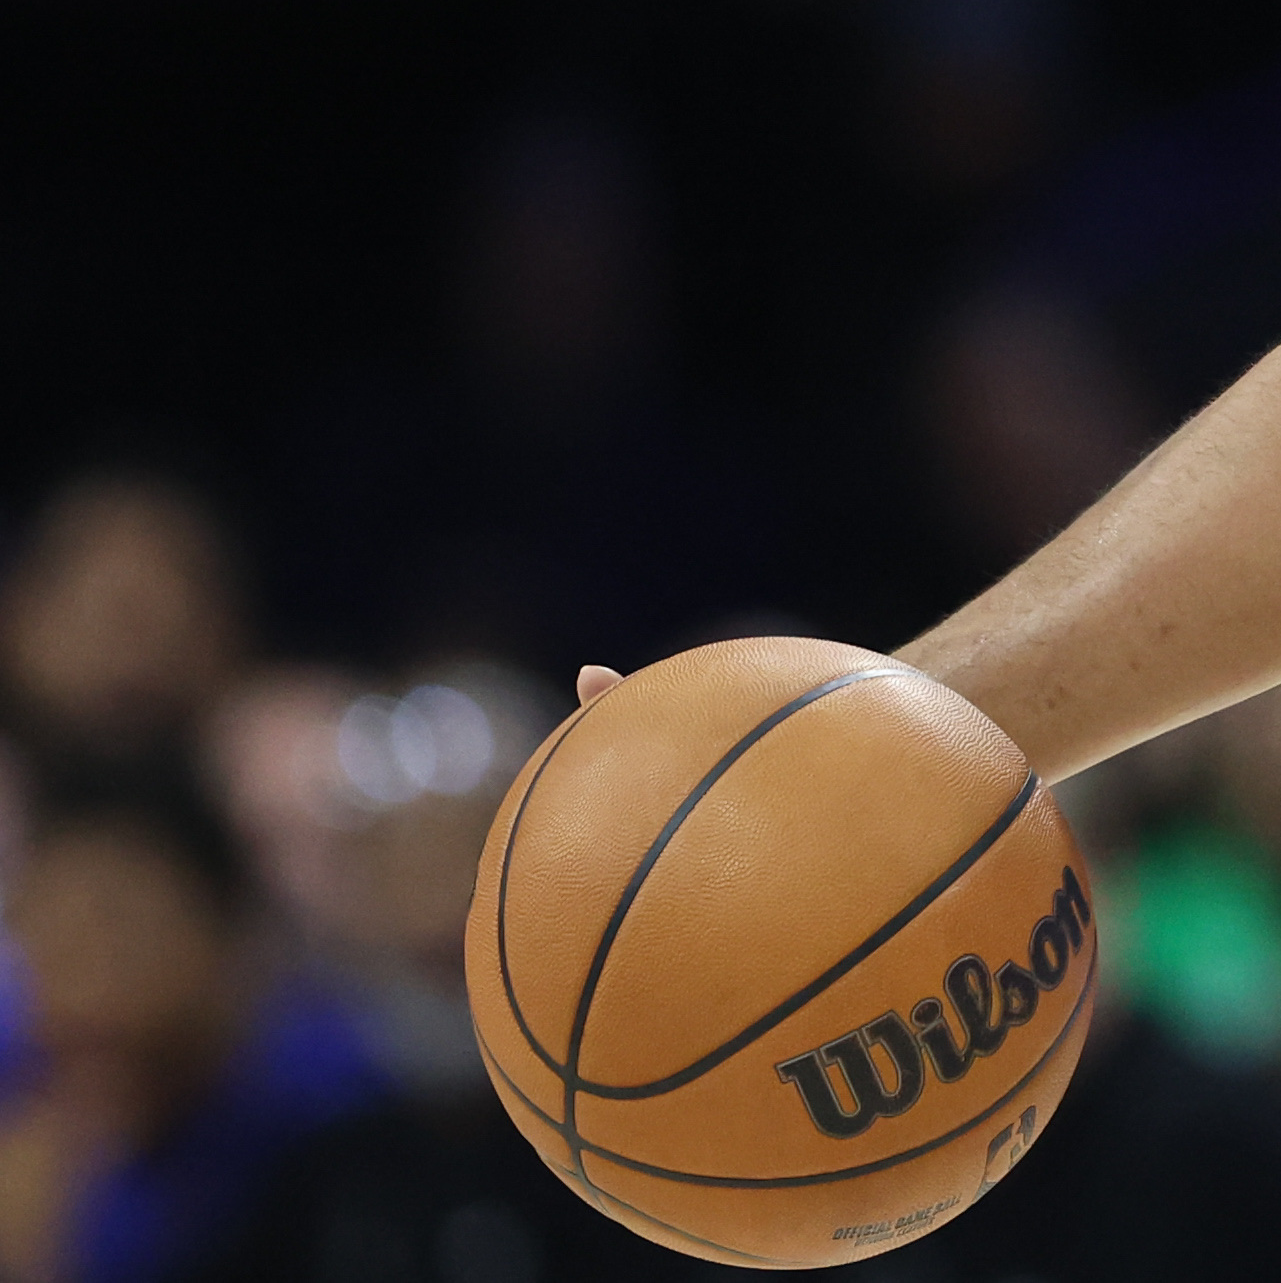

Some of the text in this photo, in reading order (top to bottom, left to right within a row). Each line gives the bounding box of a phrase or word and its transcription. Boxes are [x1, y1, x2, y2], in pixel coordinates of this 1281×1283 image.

[773, 863, 1092, 1141] Wilson
[831, 1219, 893, 1241] OFFICIAL
[893, 1204, 935, 1230] GAME
